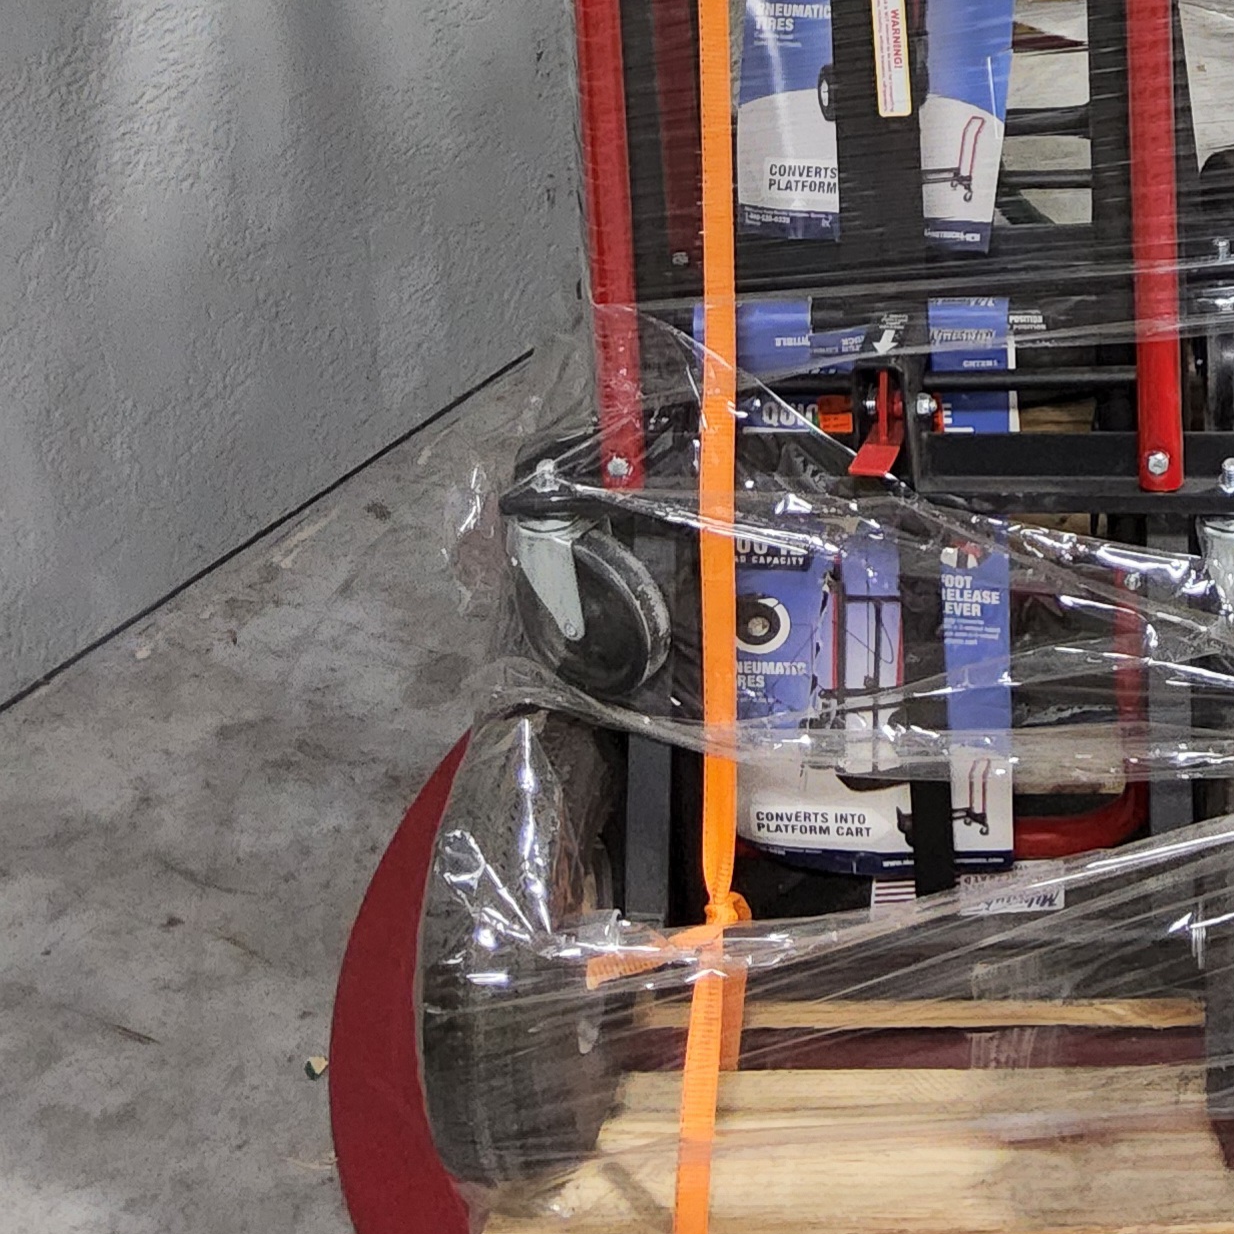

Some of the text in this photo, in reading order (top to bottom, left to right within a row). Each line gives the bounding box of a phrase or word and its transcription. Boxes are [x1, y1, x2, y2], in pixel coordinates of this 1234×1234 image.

[890, 9, 903, 69] WARNING!
[769, 163, 838, 179] CONVERTS
[768, 178, 838, 194] PLATFORM
[751, 555, 805, 566] CAPACITY
[756, 810, 867, 825] CONVERTS INTO
[757, 822, 873, 838] PLATFORM CART
